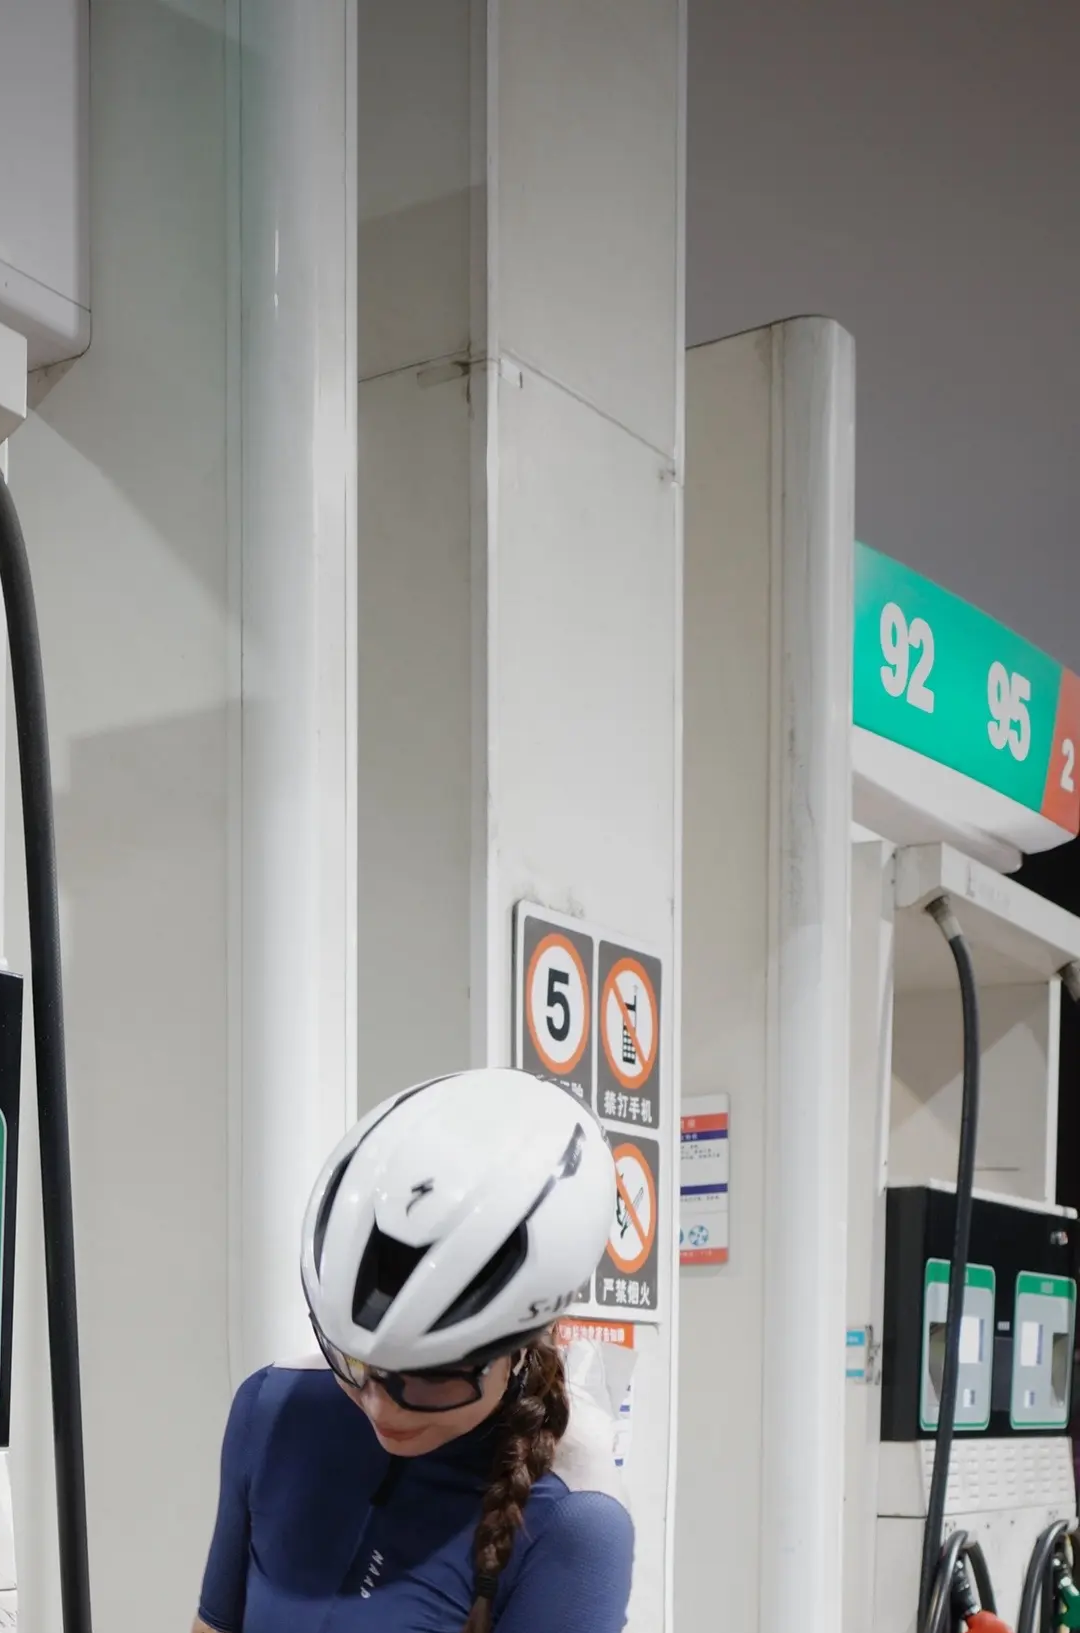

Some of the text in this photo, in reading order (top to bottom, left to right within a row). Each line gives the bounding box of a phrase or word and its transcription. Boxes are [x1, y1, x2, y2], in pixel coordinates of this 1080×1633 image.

[879, 601, 1032, 762] 92 95
[1059, 738, 1075, 793] 2
[545, 966, 571, 1042] 5
[603, 1090, 653, 1123] 禁打手机
[603, 1278, 651, 1306] 严禁烟火
